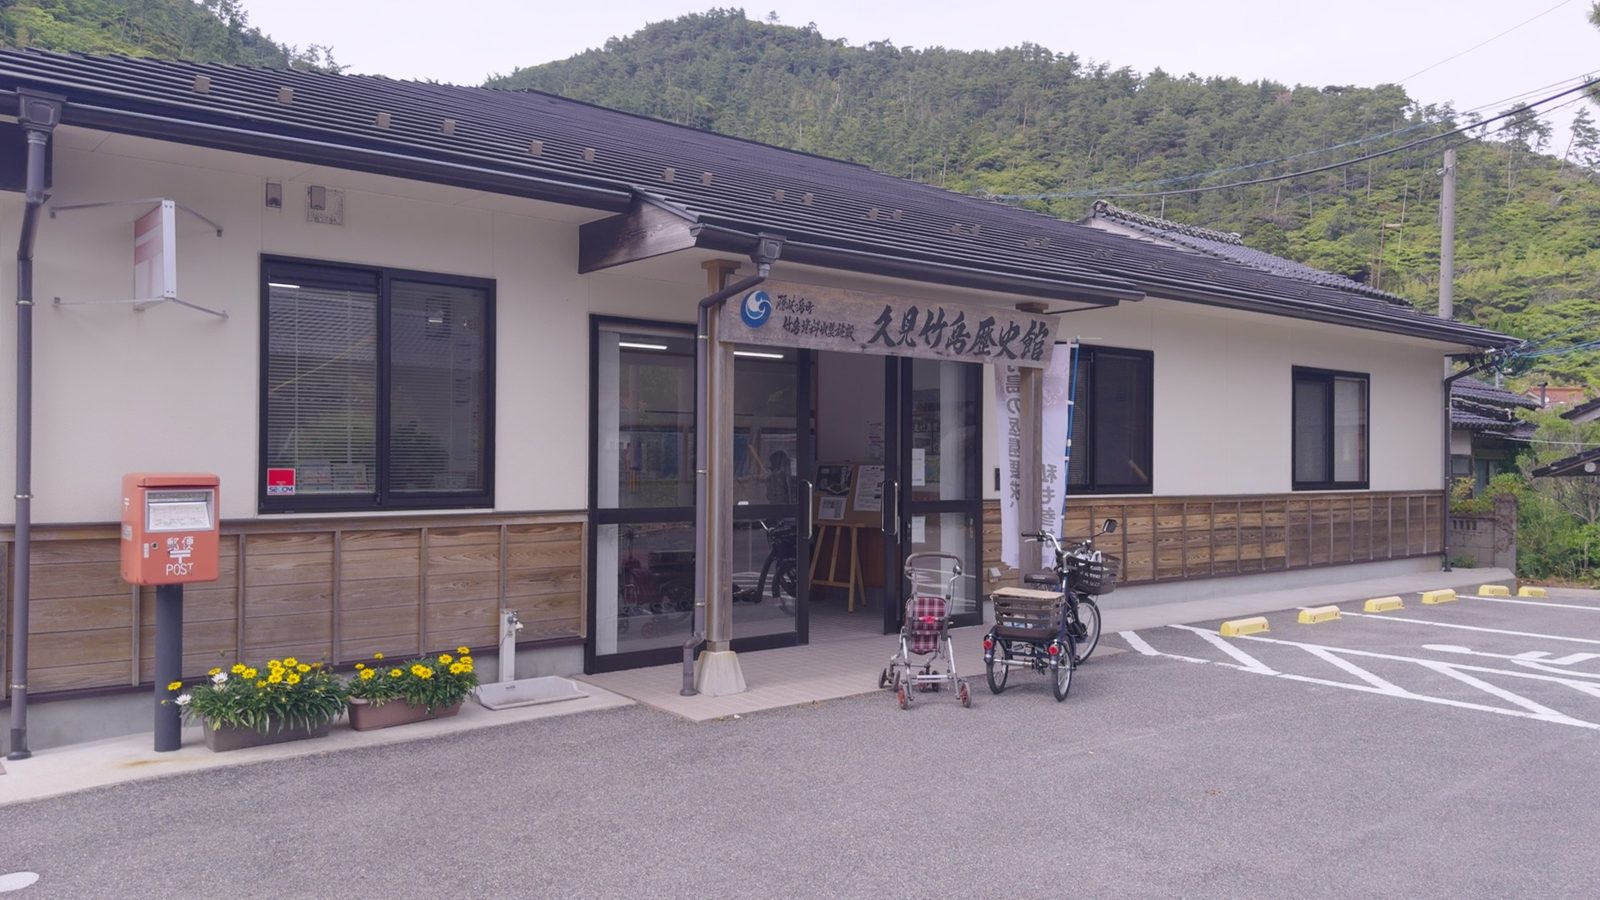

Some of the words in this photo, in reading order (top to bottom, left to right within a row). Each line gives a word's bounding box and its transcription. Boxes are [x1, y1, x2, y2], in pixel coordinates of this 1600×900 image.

[867, 303, 1050, 362] 久見竹島歴史館
[165, 562, 195, 577] POST
